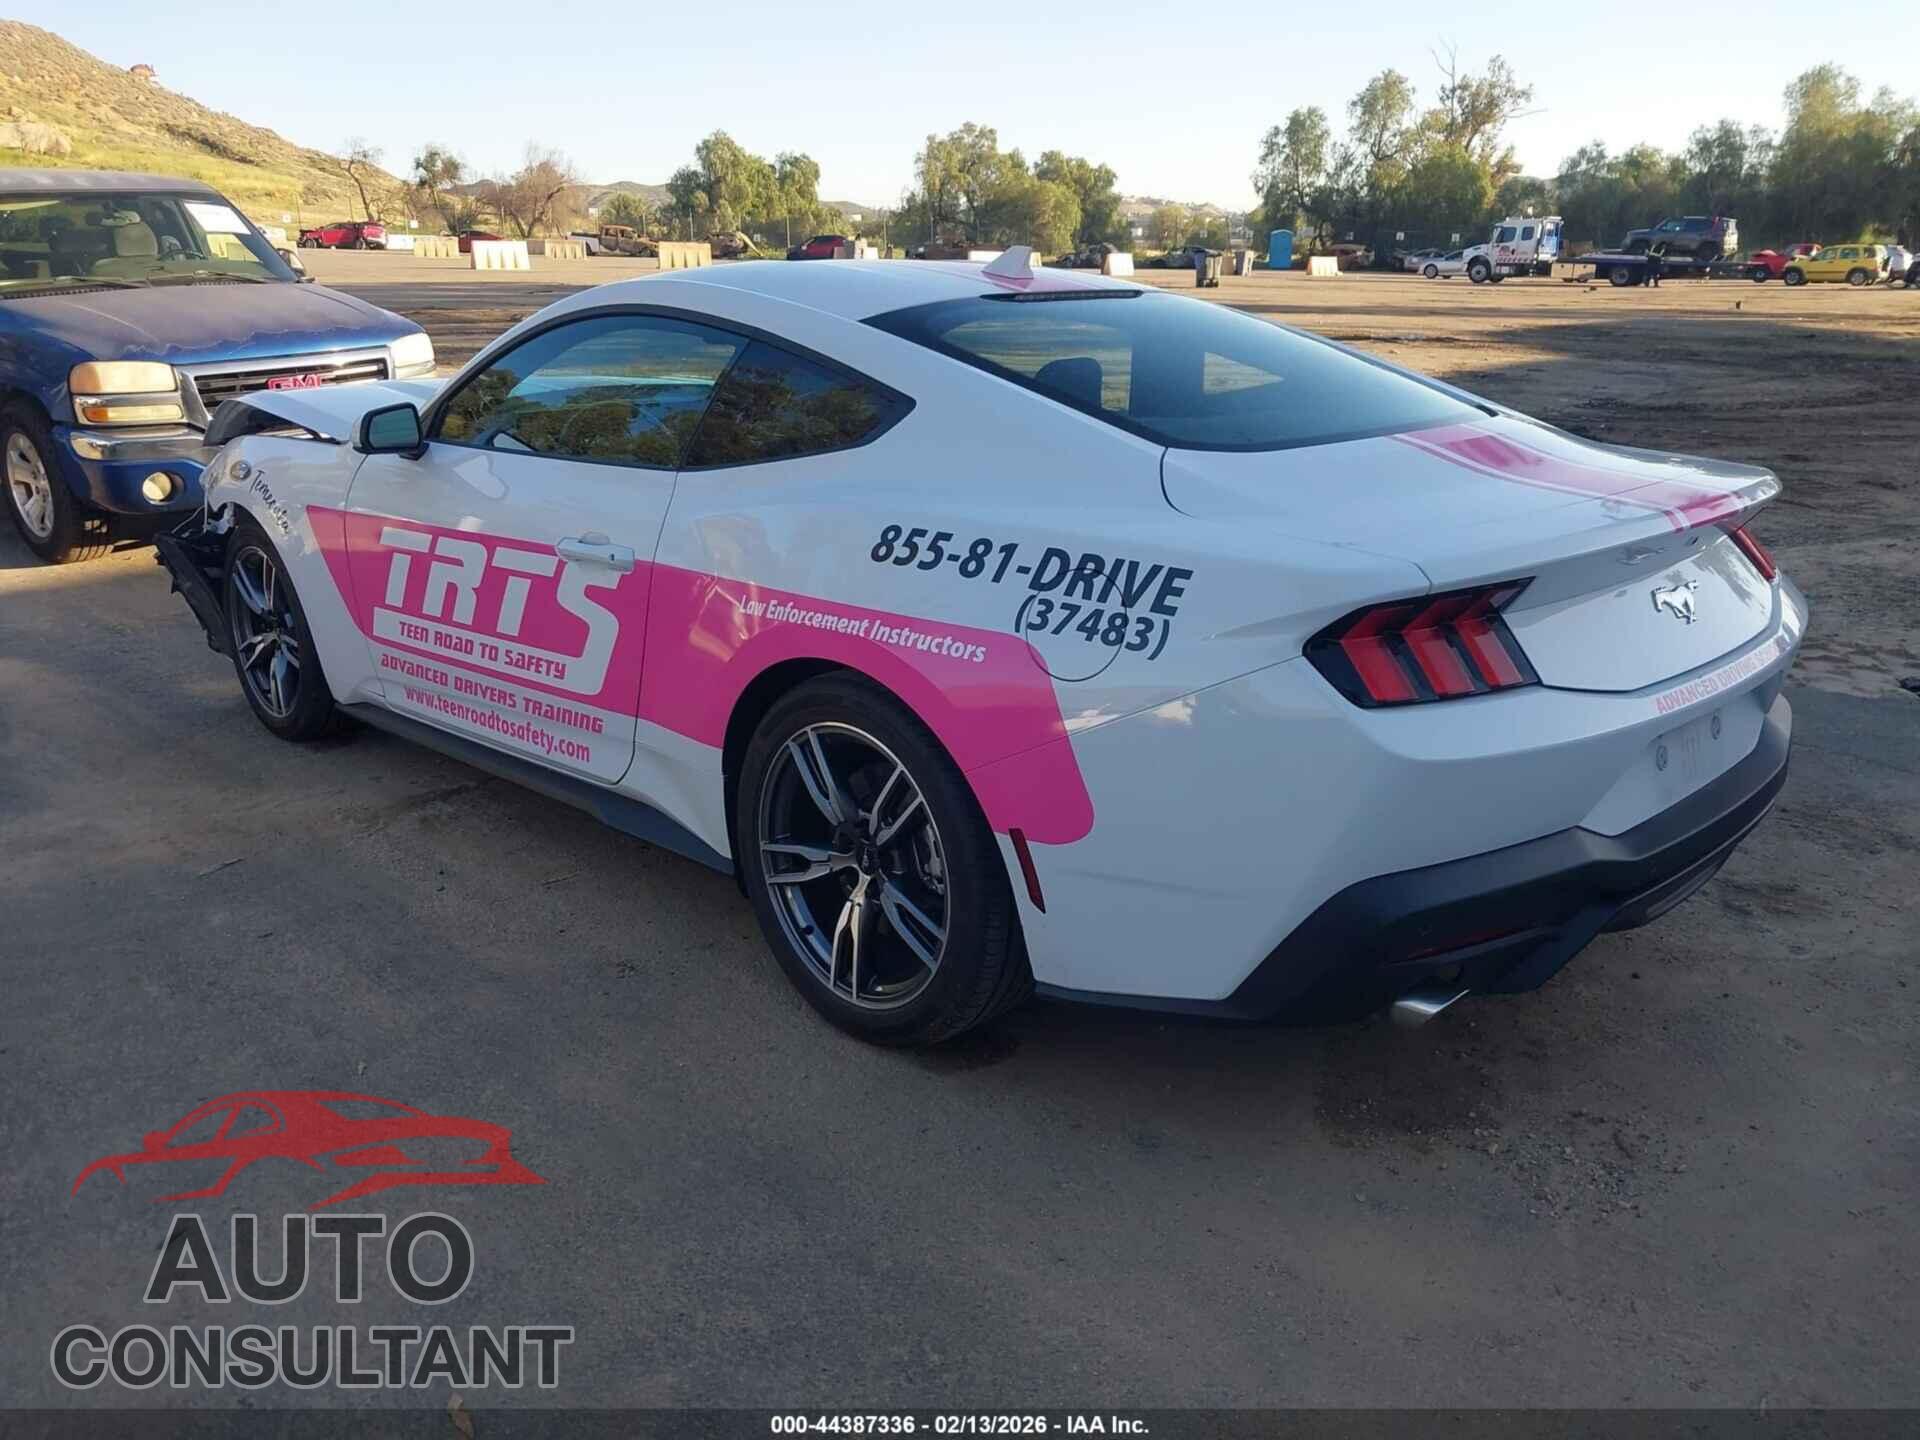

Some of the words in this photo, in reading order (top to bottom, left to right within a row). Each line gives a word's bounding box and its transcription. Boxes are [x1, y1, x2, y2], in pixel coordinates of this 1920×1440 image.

[375, 526, 620, 680] TRTS
[870, 524, 1194, 617] 855-81-DRIVE
[399, 620, 429, 644] TEEN
[434, 630, 474, 656] ROAD
[479, 641, 499, 662] TO
[504, 649, 566, 680] SAFETY
[739, 594, 764, 617] Law
[766, 599, 870, 638] Enforcement
[870, 619, 987, 663] Instructors
[1014, 594, 1170, 661] (37483)
[380, 653, 449, 688] ADVANCED
[453, 675, 517, 709] DRIVERS
[522, 696, 604, 735] TRAINING
[403, 685, 591, 763] www.teenroadtosafety.com
